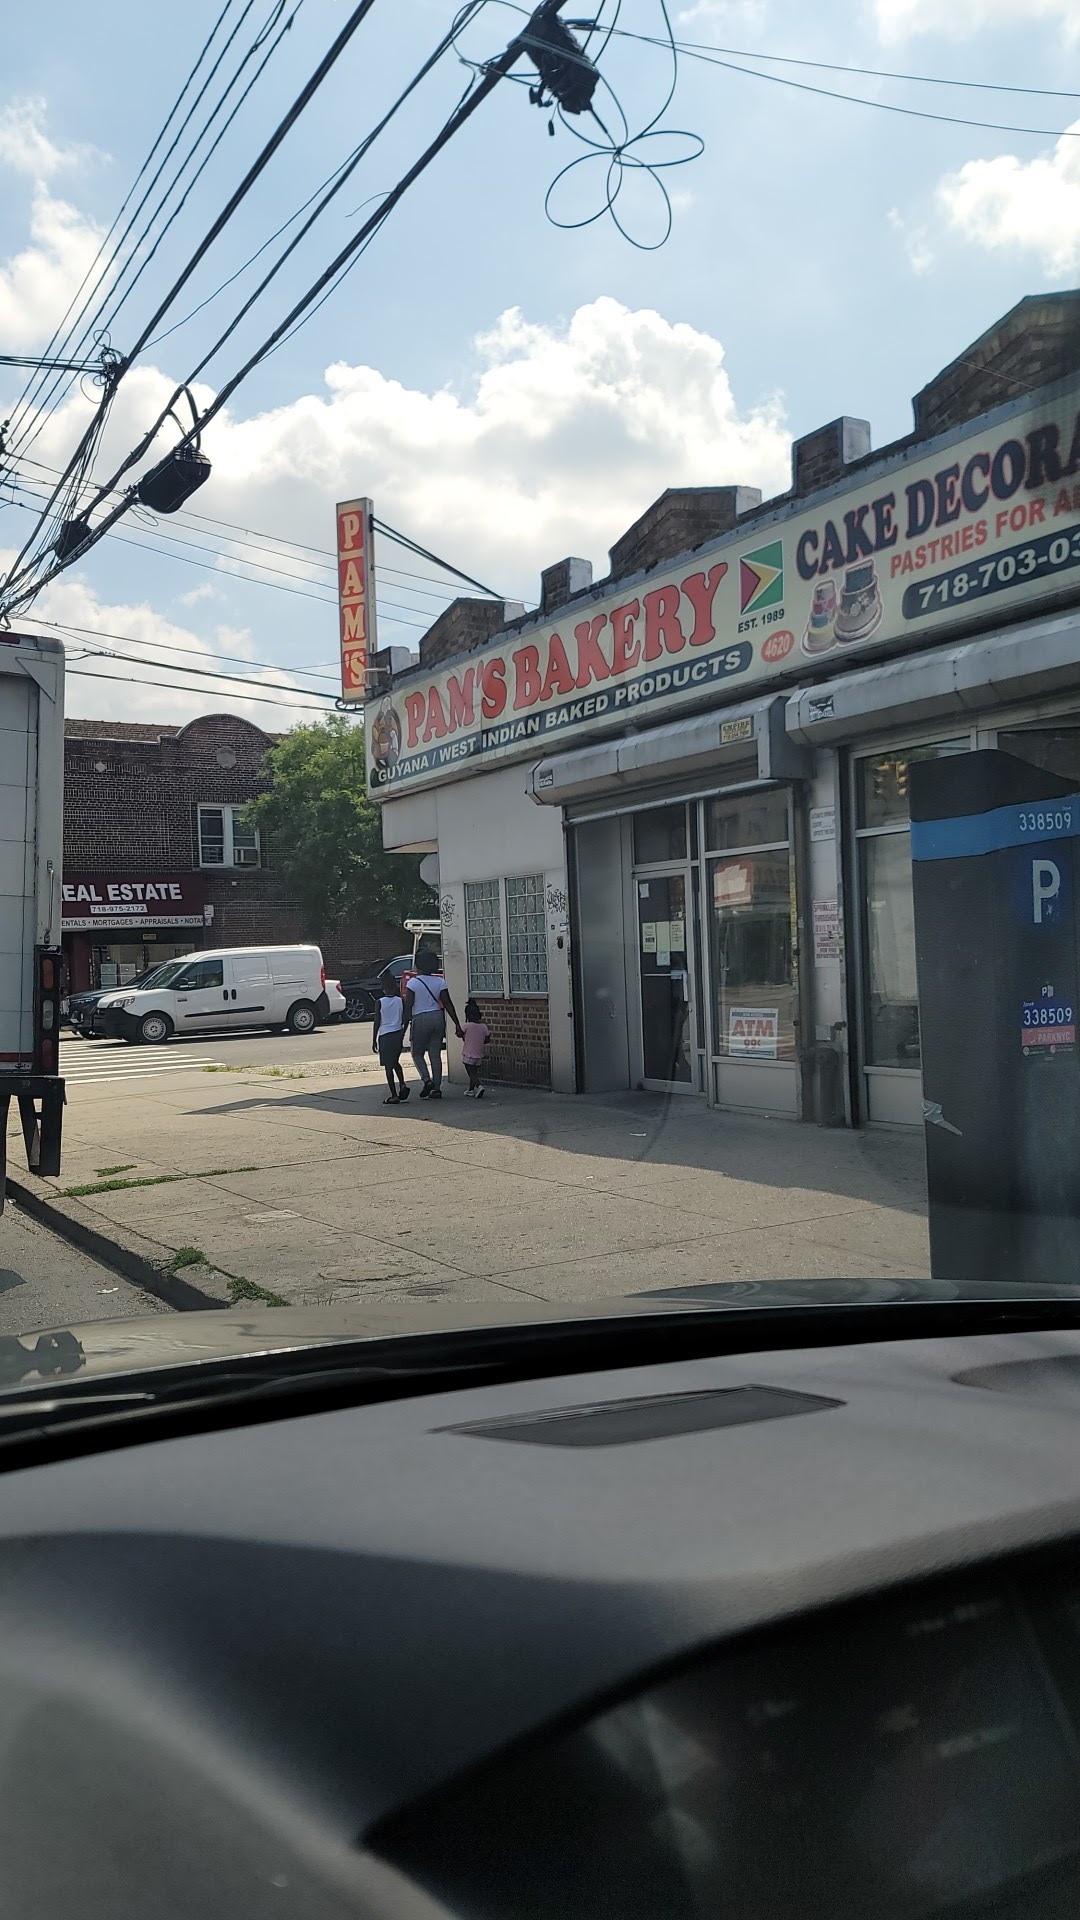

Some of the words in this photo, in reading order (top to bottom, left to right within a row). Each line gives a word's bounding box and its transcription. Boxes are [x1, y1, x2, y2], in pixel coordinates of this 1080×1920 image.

[796, 491, 899, 581] CAKE
[890, 520, 987, 578] PASTRIES
[995, 498, 1046, 539] FOR
[341, 514, 367, 687] PAM'S
[738, 618, 758, 633] EST.
[761, 608, 784, 625] 1989
[405, 657, 506, 749] PAM'S
[512, 562, 728, 711] BAKERY
[377, 758, 429, 783] GUYANA
[439, 737, 477, 761] WEST
[482, 717, 540, 748] INDIAN
[545, 695, 608, 729] BAKED
[614, 650, 742, 706] PRODUCTS
[1019, 812, 1071, 831] 338509
[62, 884, 103, 902] EAL
[107, 883, 183, 901] ESTATE
[1032, 860, 1060, 923] P
[92, 905, 145, 913] 718-975-2172
[62, 919, 87, 927] ENTALS
[92, 918, 134, 927] MORTGAGES
[140, 917, 179, 925] APPRAISALS
[732, 1019, 774, 1037] ATM
[1023, 1007, 1072, 1025] 338509
